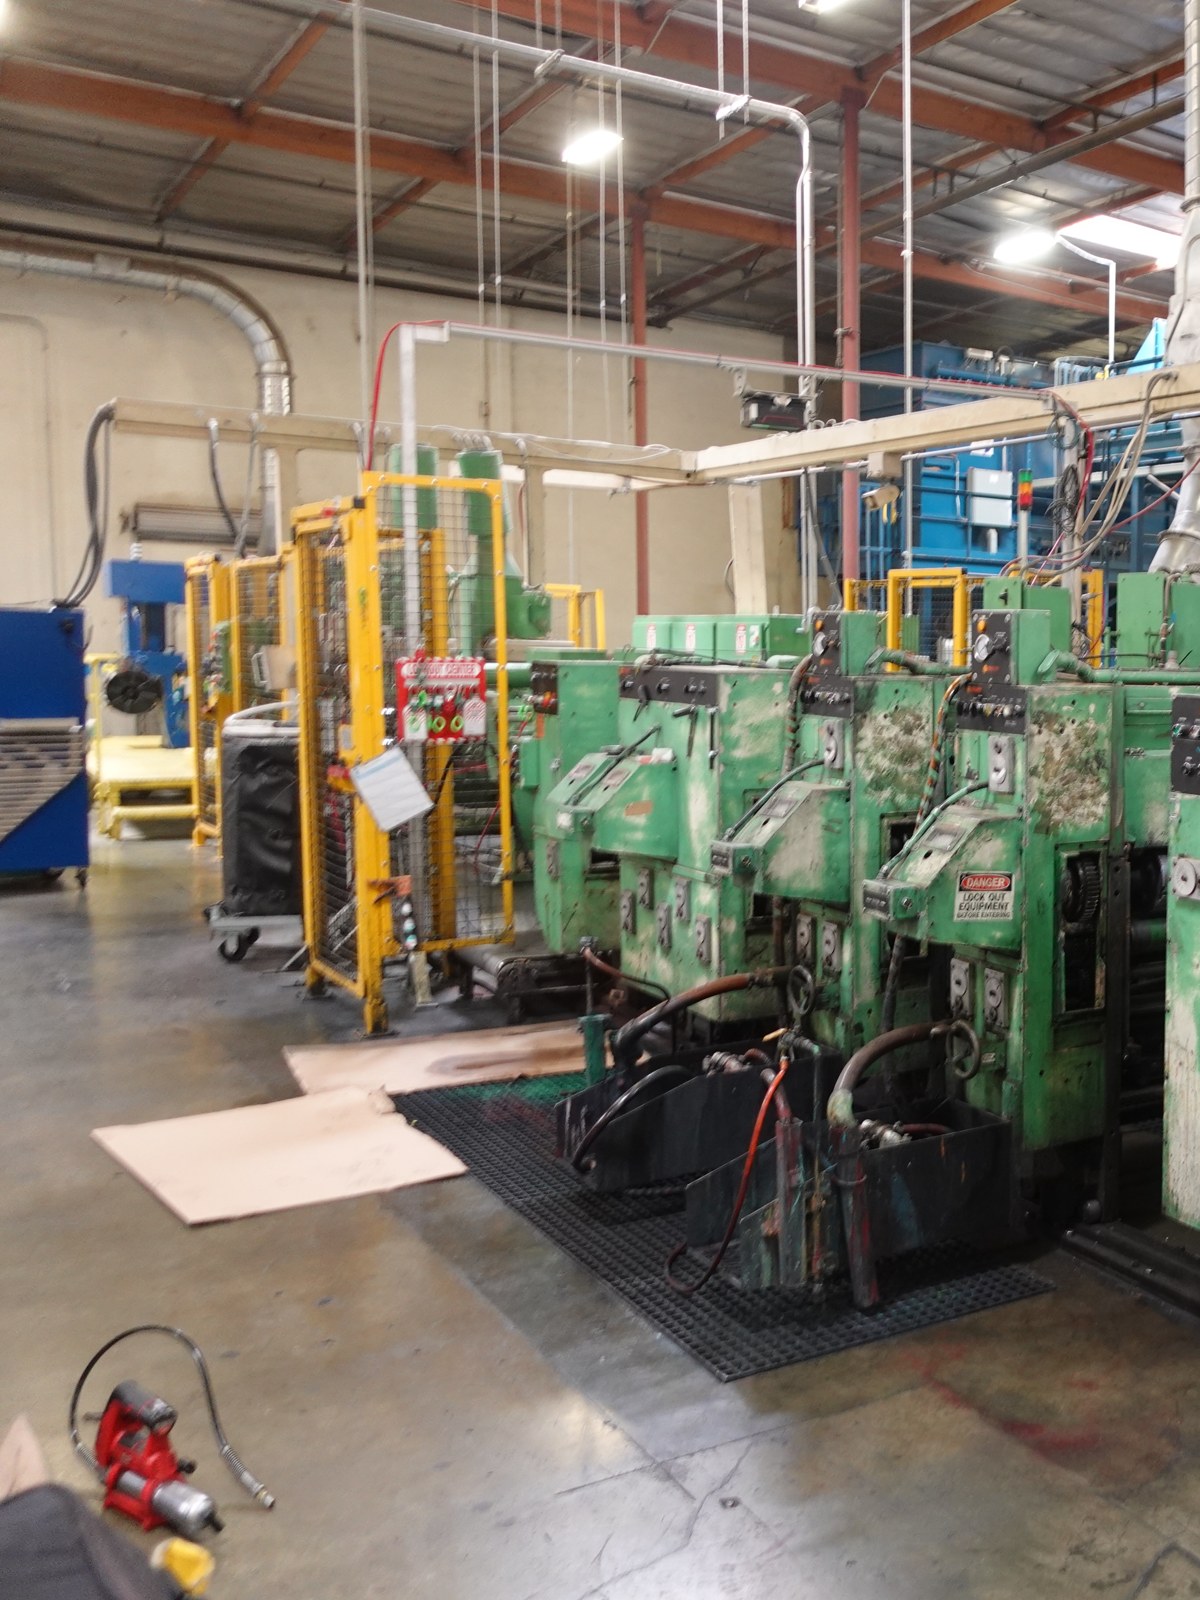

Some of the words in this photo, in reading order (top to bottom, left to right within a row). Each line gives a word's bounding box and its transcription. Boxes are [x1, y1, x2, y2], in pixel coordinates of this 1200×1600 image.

[408, 663, 443, 675] LOKOUT
[966, 876, 1006, 888] DANGER
[963, 892, 986, 901] LOCK
[988, 892, 1007, 901] OUT
[958, 901, 1010, 911] EQUIPMENT
[956, 911, 980, 919] BEFORE
[980, 911, 1011, 919] ENTERING
